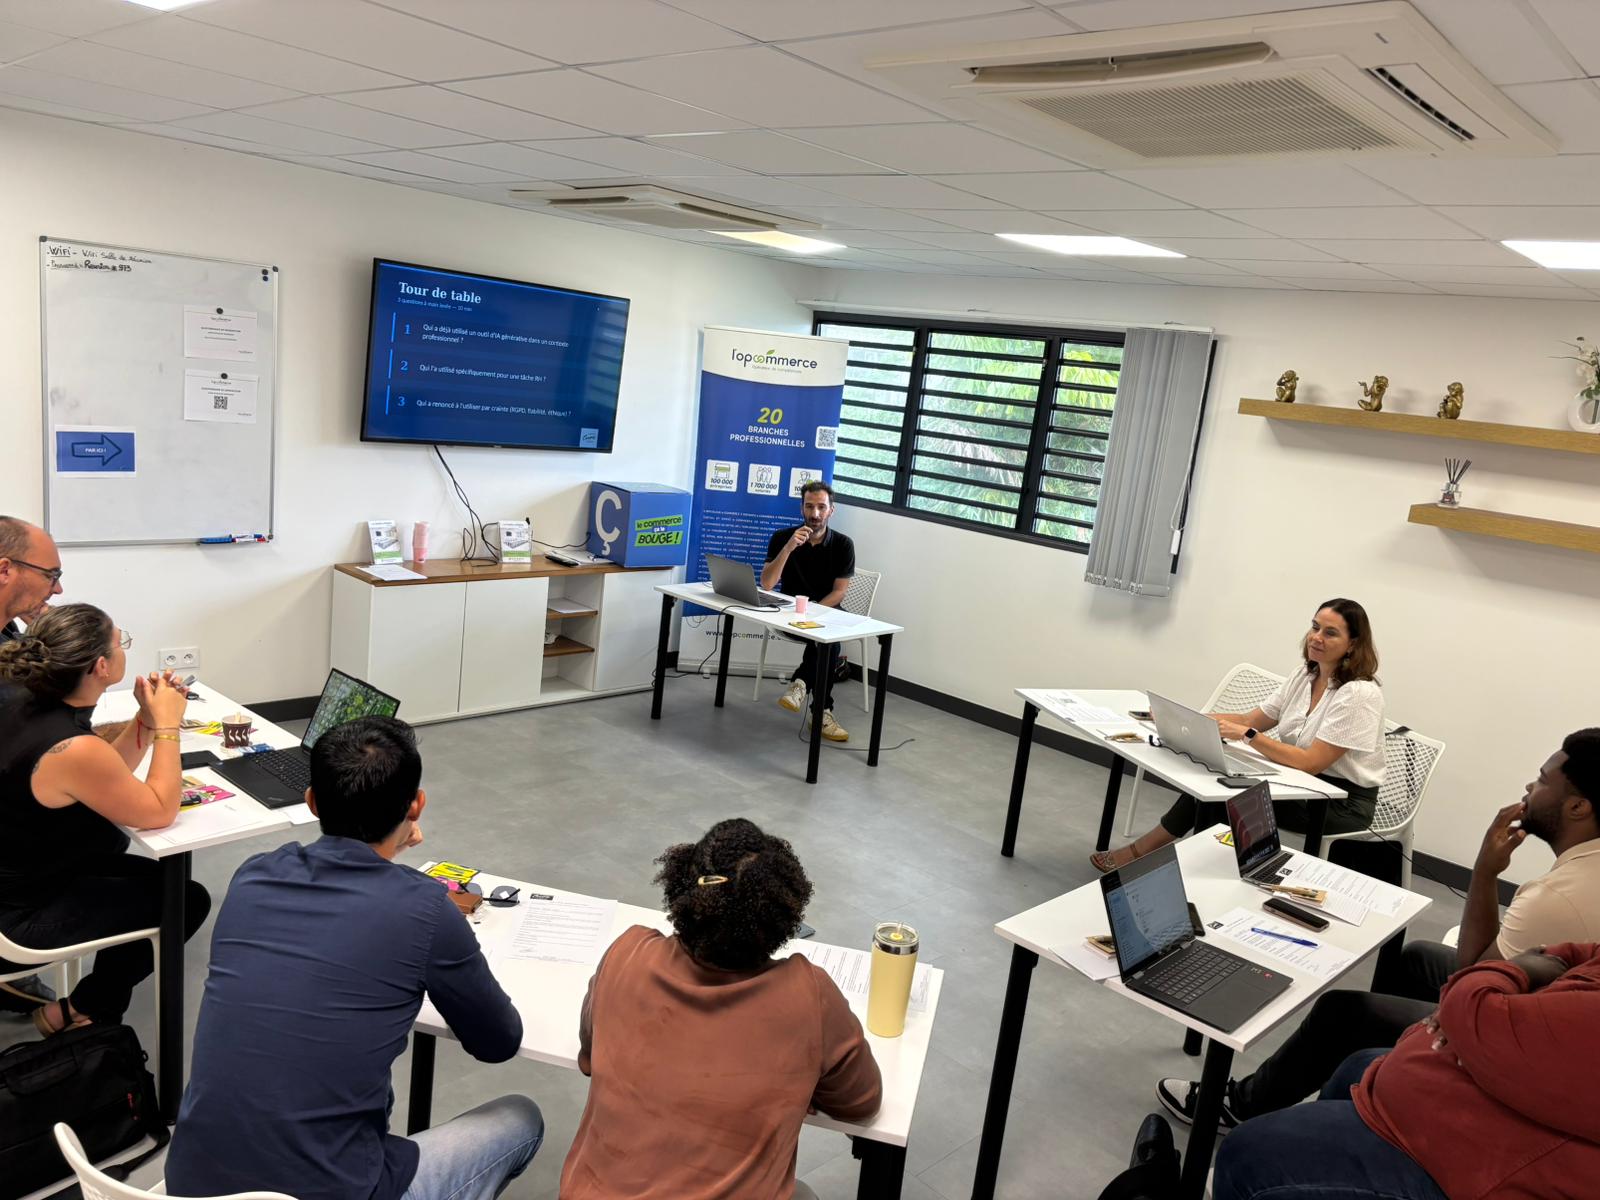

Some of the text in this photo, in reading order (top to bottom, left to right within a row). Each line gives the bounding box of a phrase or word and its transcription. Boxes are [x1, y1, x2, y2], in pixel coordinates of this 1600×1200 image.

[399, 282, 482, 304] Tour de table
[405, 324, 411, 335] 1
[439, 326, 451, 334] déjà
[422, 334, 459, 343] professionnel
[400, 360, 408, 371] 2
[419, 364, 430, 372] Qui
[455, 367, 496, 378] spécifiquement
[398, 396, 405, 406] 3
[416, 399, 427, 407] Qui
[757, 407, 783, 425] 20
[748, 425, 789, 437] BRANCHES
[729, 433, 806, 448] PROFESSIONNELLES
[595, 490, 622, 556] Ç
[643, 516, 682, 528] commerce
[638, 532, 673, 544] BOUGE
